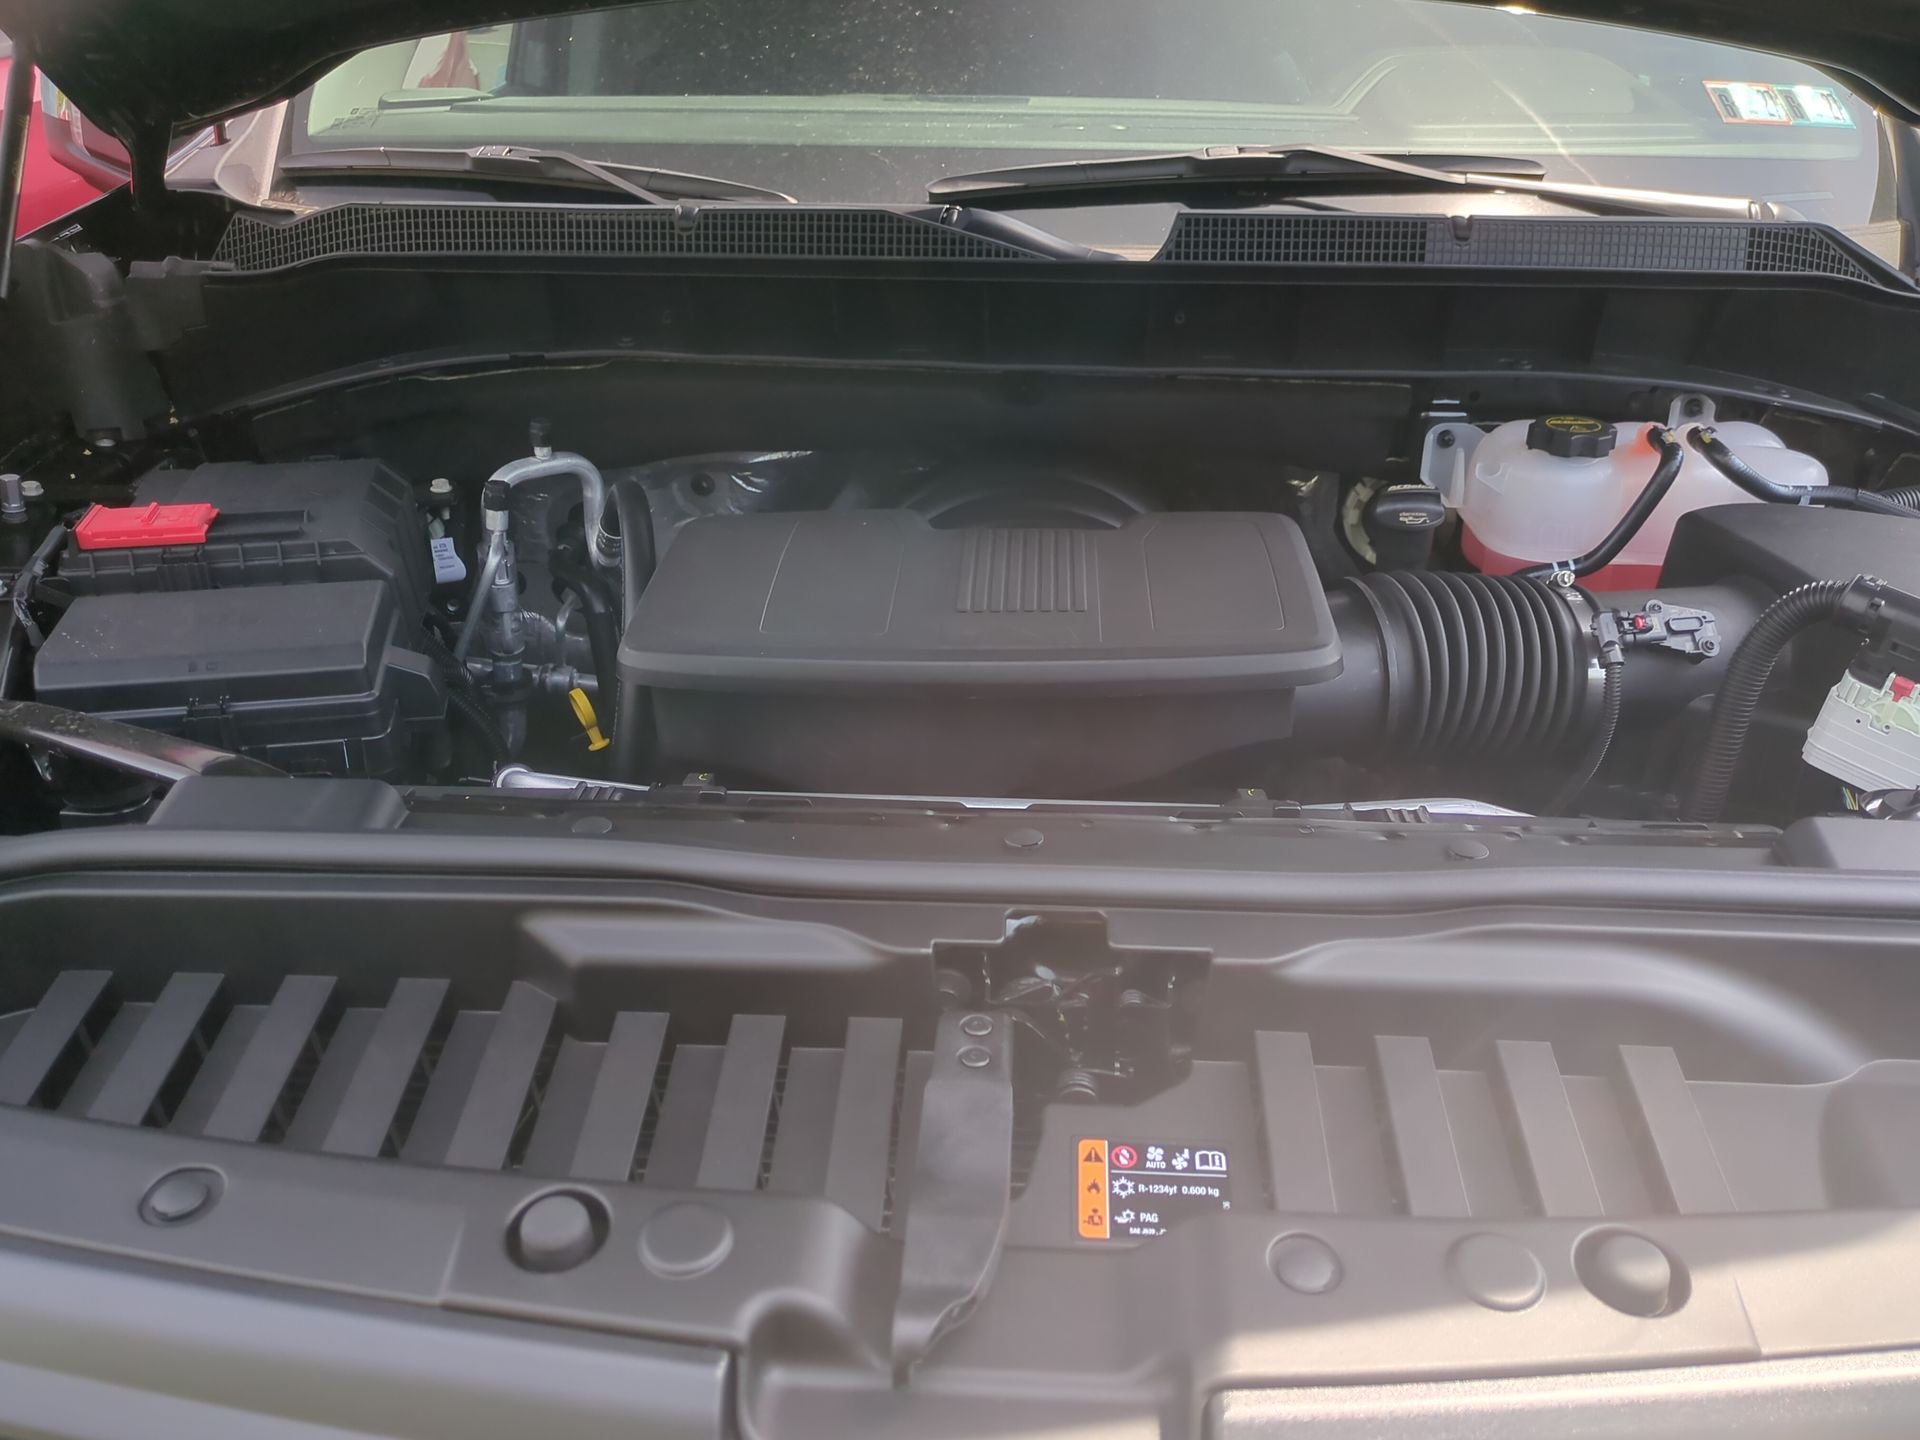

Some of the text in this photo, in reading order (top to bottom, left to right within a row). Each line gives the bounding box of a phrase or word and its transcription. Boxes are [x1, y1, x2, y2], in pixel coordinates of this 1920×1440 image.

[1145, 1161, 1166, 1170] AUTO
[1138, 1184, 1220, 1197] R-1234yf 0.600 kg
[1140, 1212, 1159, 1223] PAG
